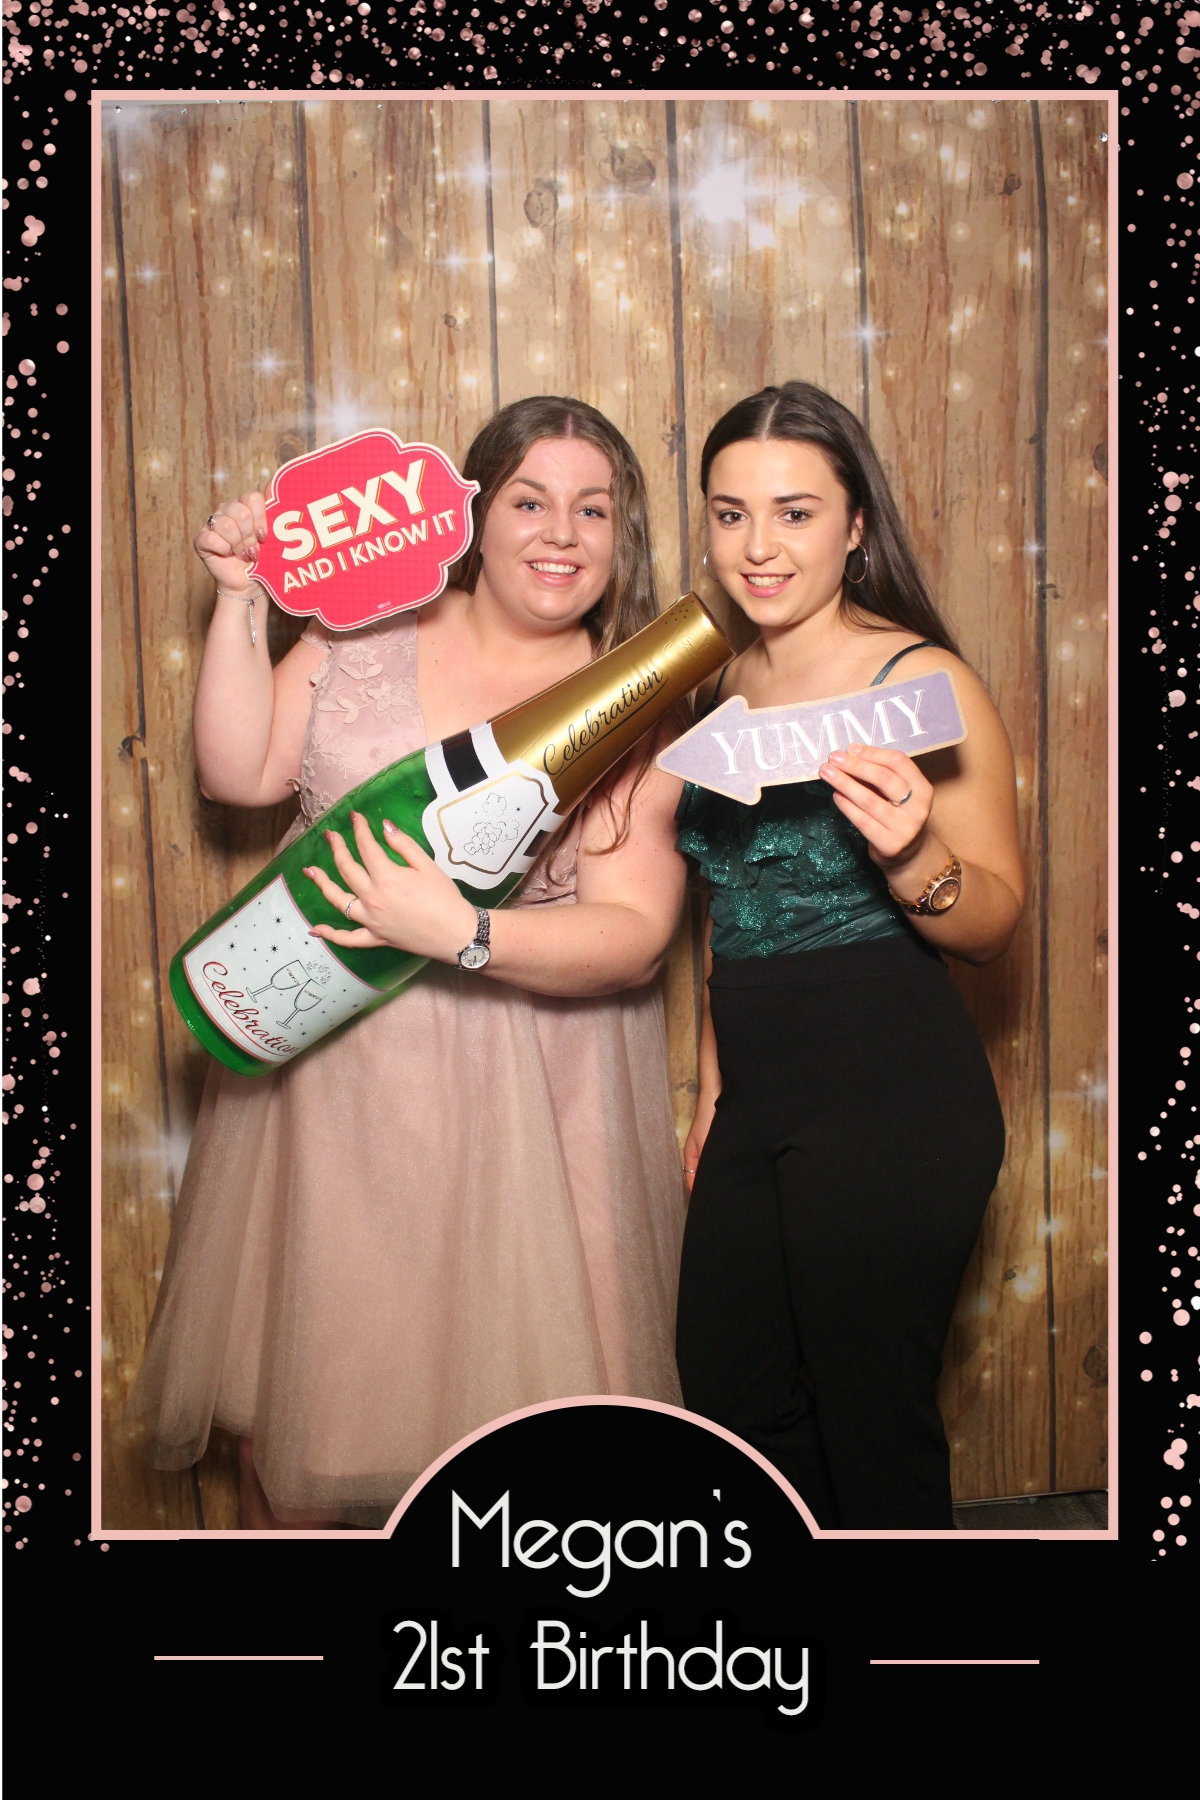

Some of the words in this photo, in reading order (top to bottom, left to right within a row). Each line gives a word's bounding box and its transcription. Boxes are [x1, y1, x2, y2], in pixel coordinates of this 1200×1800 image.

[272, 458, 427, 561] SEXY
[283, 557, 335, 593] AND
[336, 550, 349, 571] I
[349, 519, 429, 567] KNOW
[432, 508, 457, 536] IT
[542, 669, 666, 777] Celebration
[711, 689, 929, 775] YUMMY
